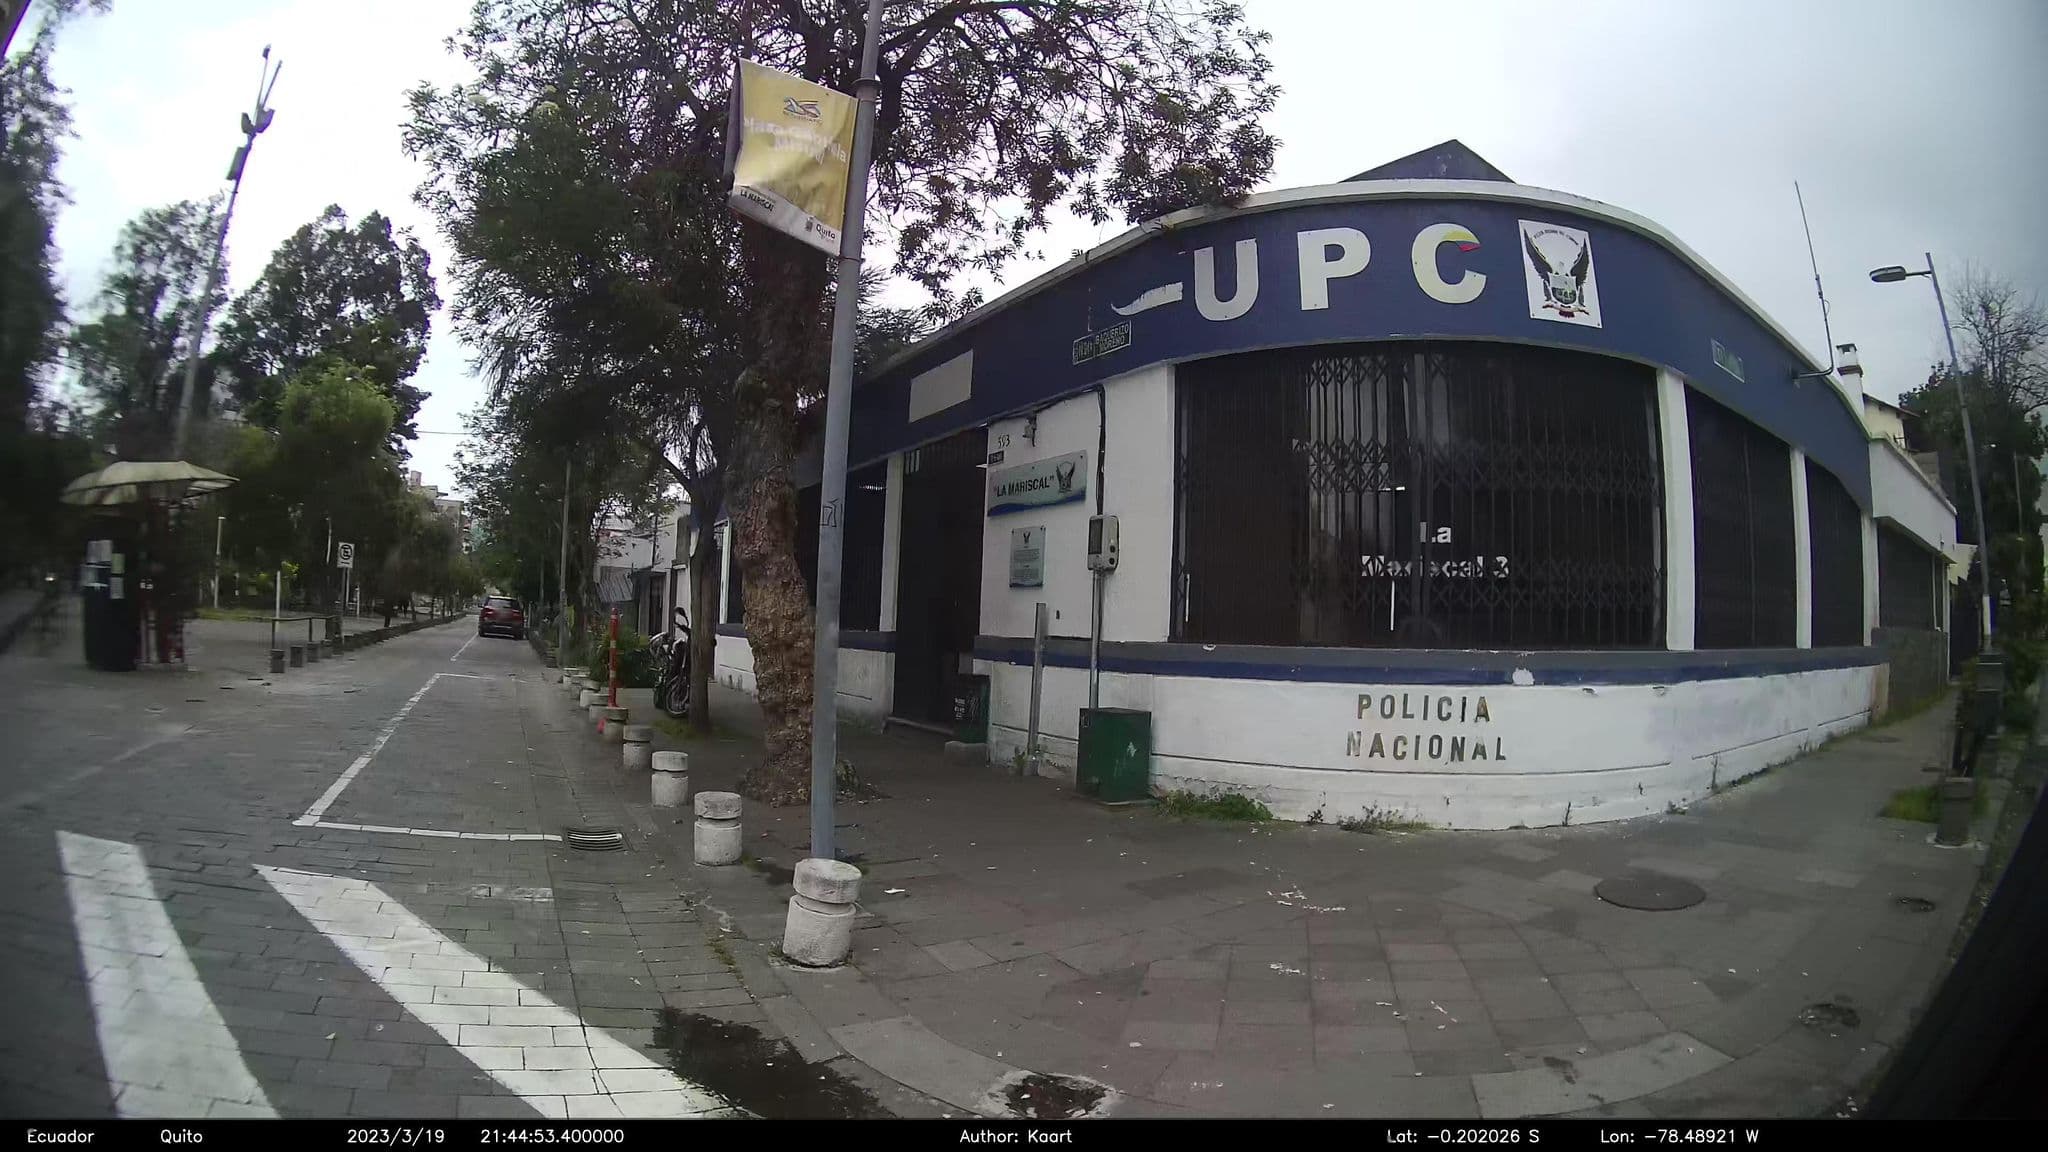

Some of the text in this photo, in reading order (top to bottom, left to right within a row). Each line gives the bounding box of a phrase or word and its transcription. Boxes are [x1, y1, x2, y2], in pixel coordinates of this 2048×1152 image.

[816, 223, 836, 240] Quito
[1193, 223, 1487, 321] UPC
[1493, 556, 1509, 578] 3
[1357, 692, 1491, 723] POLICIA
[1346, 730, 1507, 763] NACIONAL
